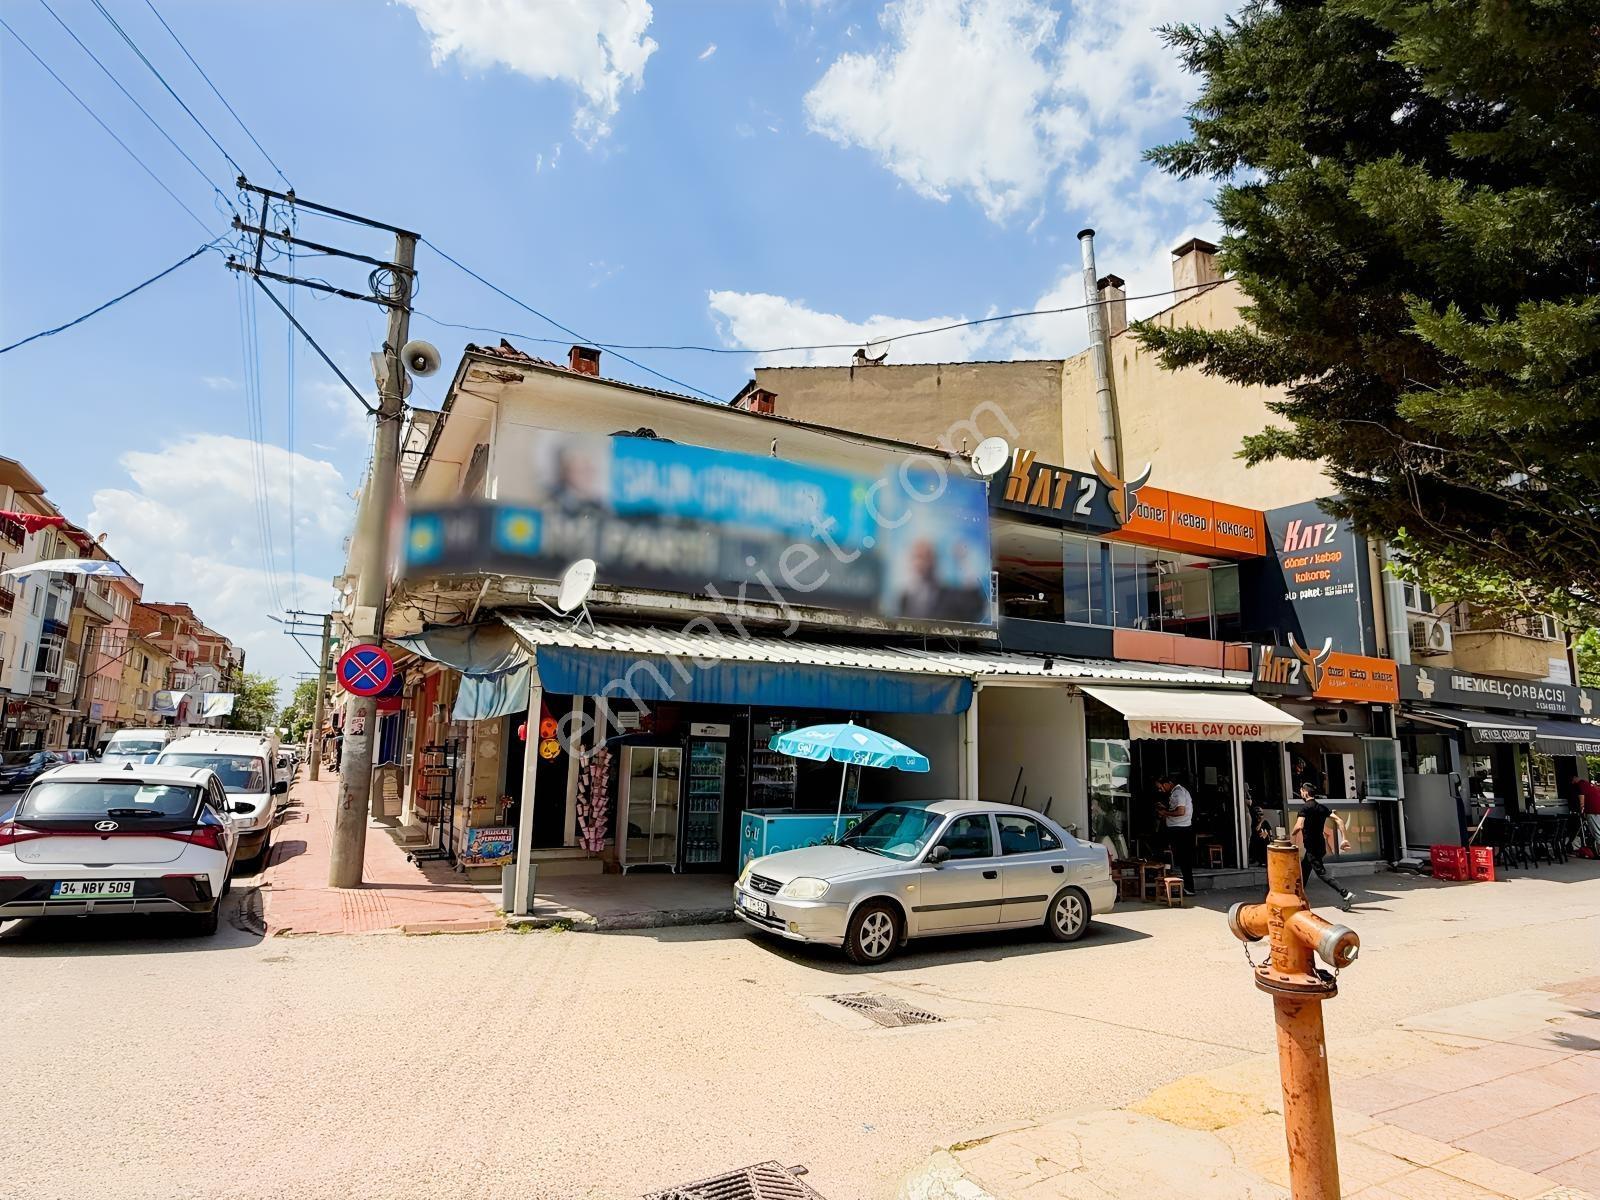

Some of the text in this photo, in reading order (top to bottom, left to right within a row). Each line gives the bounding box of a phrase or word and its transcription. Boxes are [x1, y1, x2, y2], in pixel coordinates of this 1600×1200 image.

[1003, 447, 1098, 518] KAT 2
[1283, 520, 1338, 552] KAT 2
[1150, 722, 1262, 736] HEYKEL ÇAY OCAĞI
[61, 882, 76, 894] 34
[108, 882, 131, 893] 509
